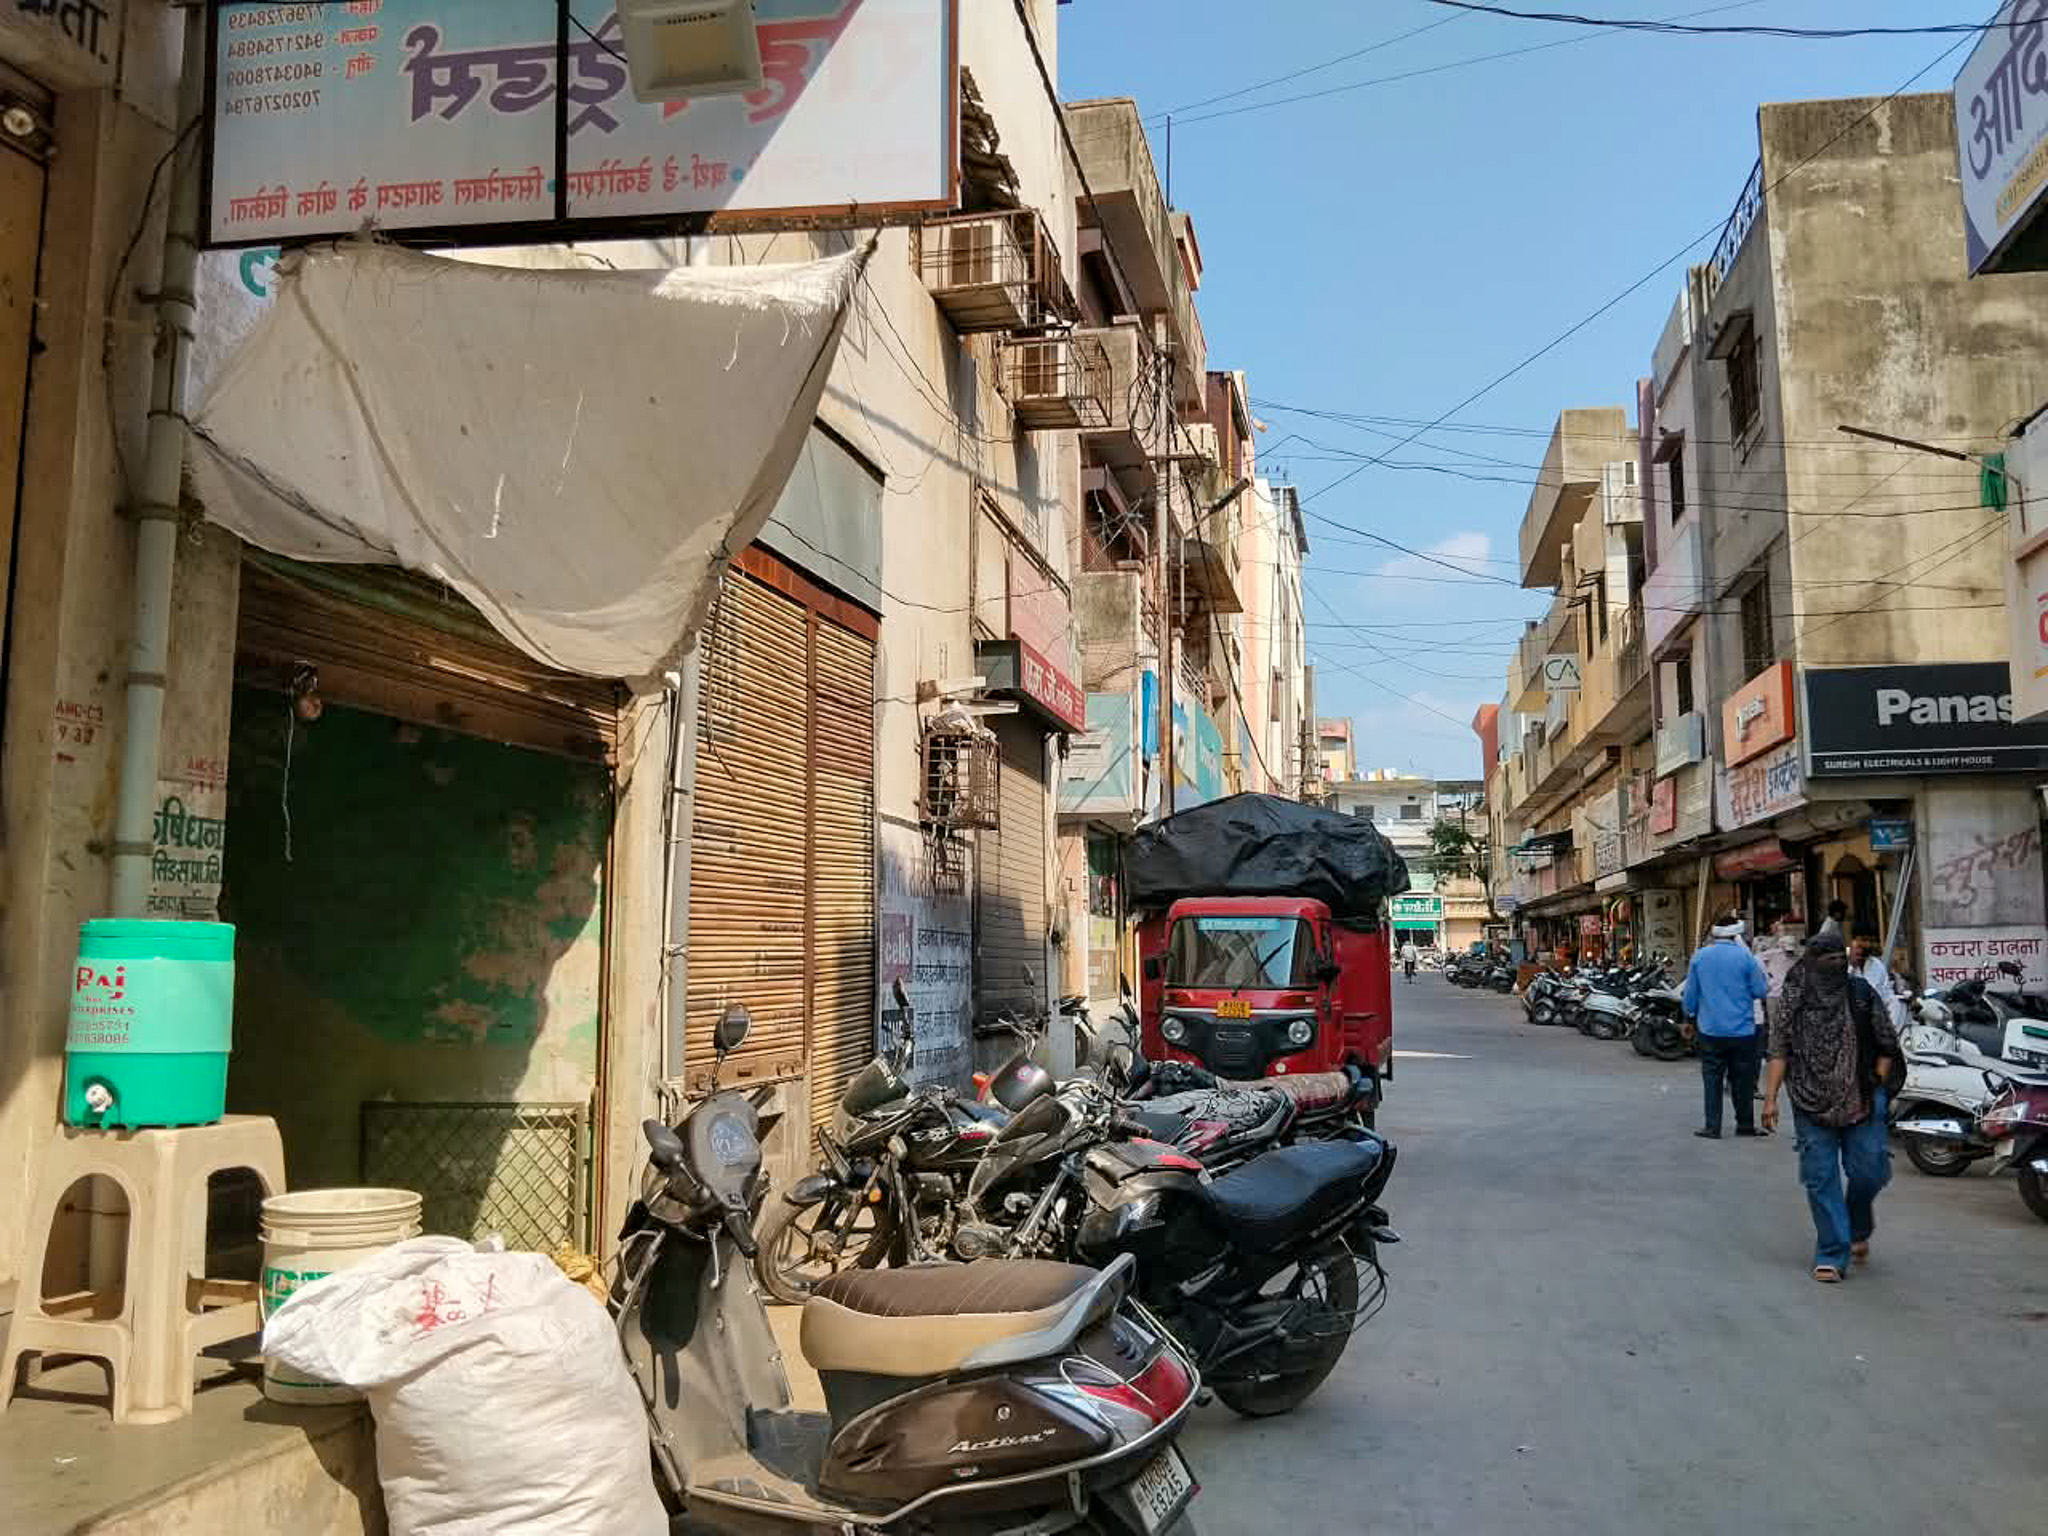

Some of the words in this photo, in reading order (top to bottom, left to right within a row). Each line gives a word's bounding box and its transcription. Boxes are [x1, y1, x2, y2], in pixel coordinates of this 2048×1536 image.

[1824, 760, 1860, 769] SURESH
[1864, 759, 1922, 768] ELECTRICALS
[1924, 758, 1930, 766] &
[1932, 757, 1959, 766] LIGHT
[1961, 756, 1993, 765] HOUSE
[1930, 939, 1984, 957] कचरा
[1987, 937, 2043, 957] डालना
